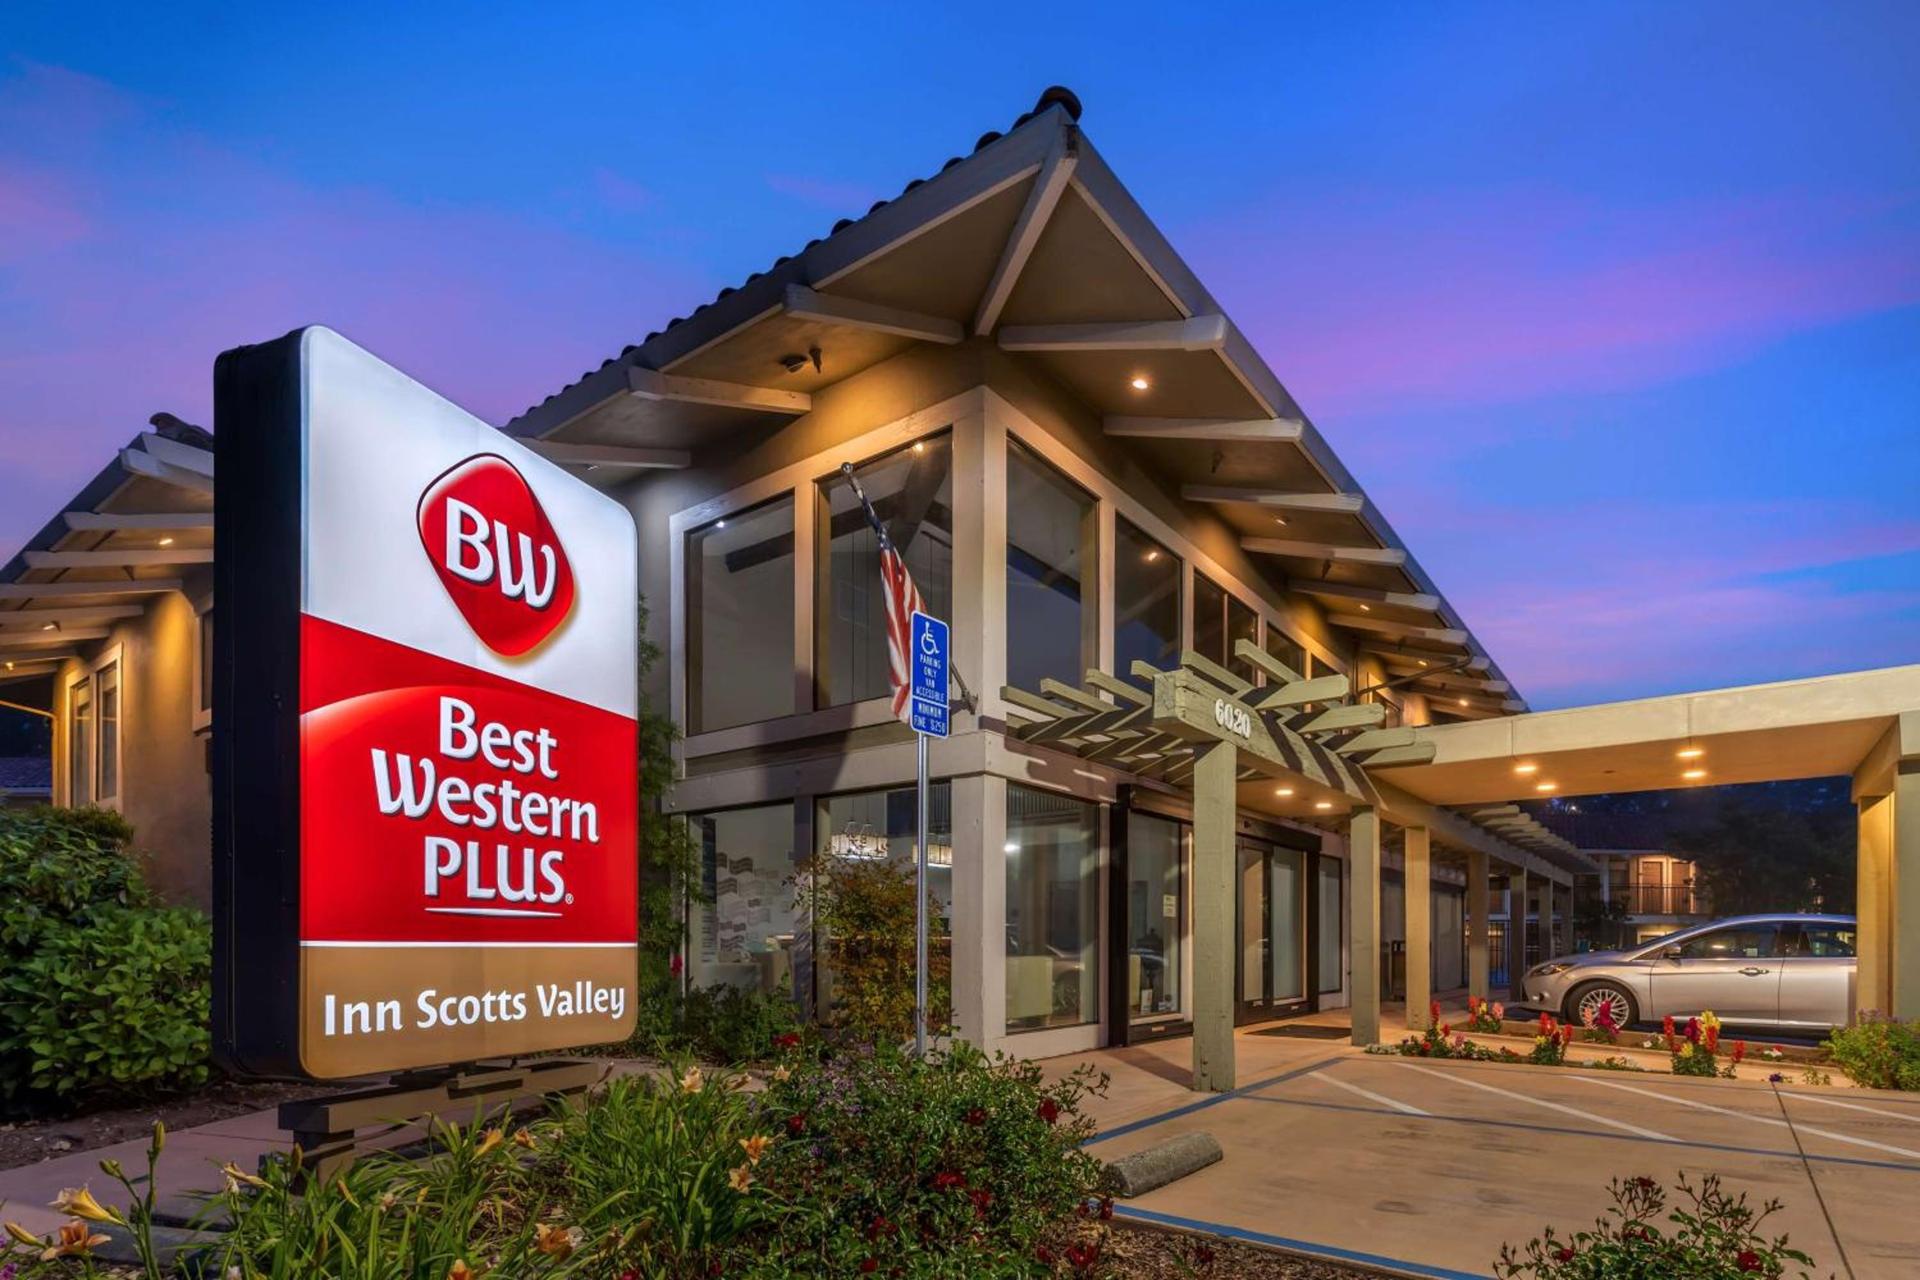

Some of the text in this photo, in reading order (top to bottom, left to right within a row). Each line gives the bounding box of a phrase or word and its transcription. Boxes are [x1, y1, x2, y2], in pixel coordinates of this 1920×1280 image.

[446, 496, 556, 608] BW
[919, 654, 941, 670] PARKING
[923, 666, 937, 679] ONLY
[916, 686, 945, 702] ACCESSIBLE
[439, 696, 558, 779] Best
[1215, 698, 1251, 739] 6020
[371, 748, 600, 843] Western
[324, 980, 625, 1036] Inn Scotts Valley
